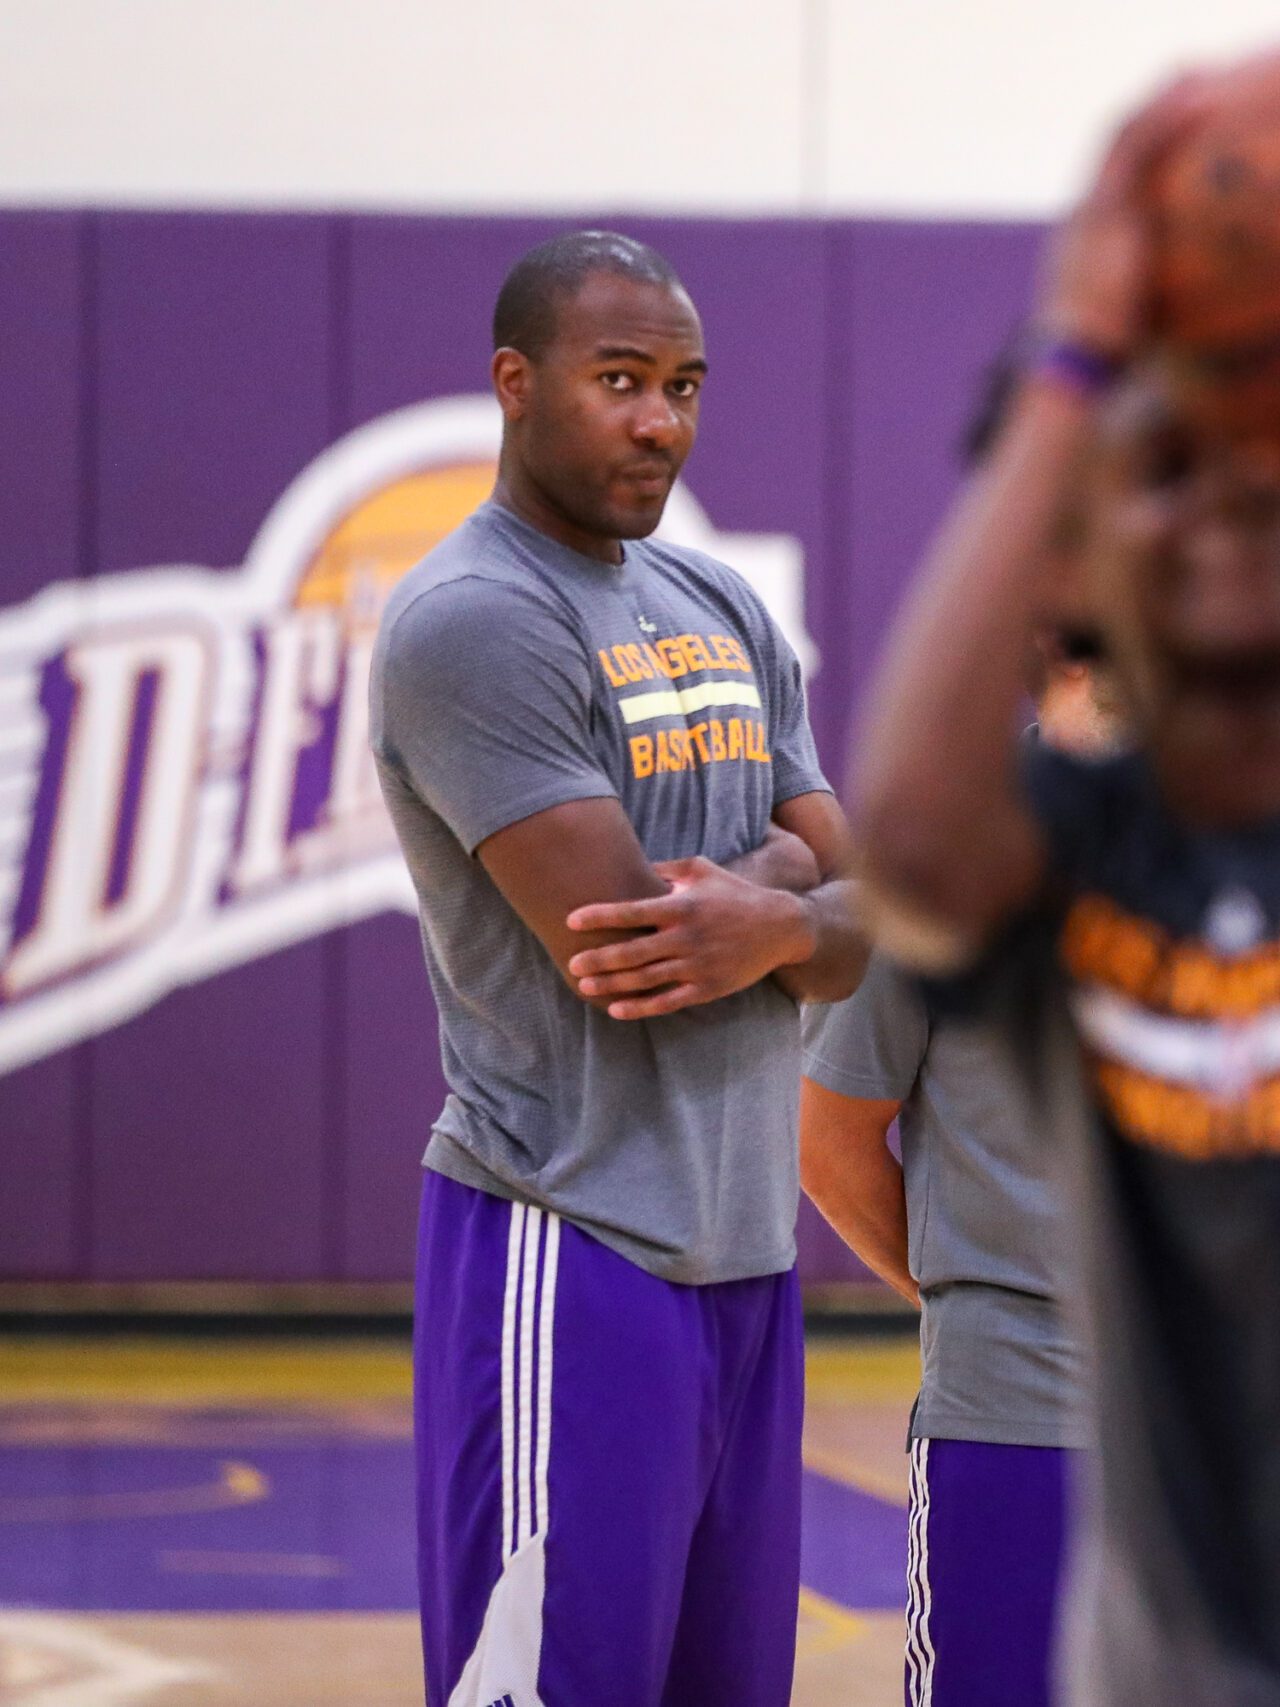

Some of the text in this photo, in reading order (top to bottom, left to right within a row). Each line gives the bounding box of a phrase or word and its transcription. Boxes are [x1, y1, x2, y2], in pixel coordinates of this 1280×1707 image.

[597, 633, 752, 688] LOS AGELES
[628, 717, 773, 780] BASKTBALL
